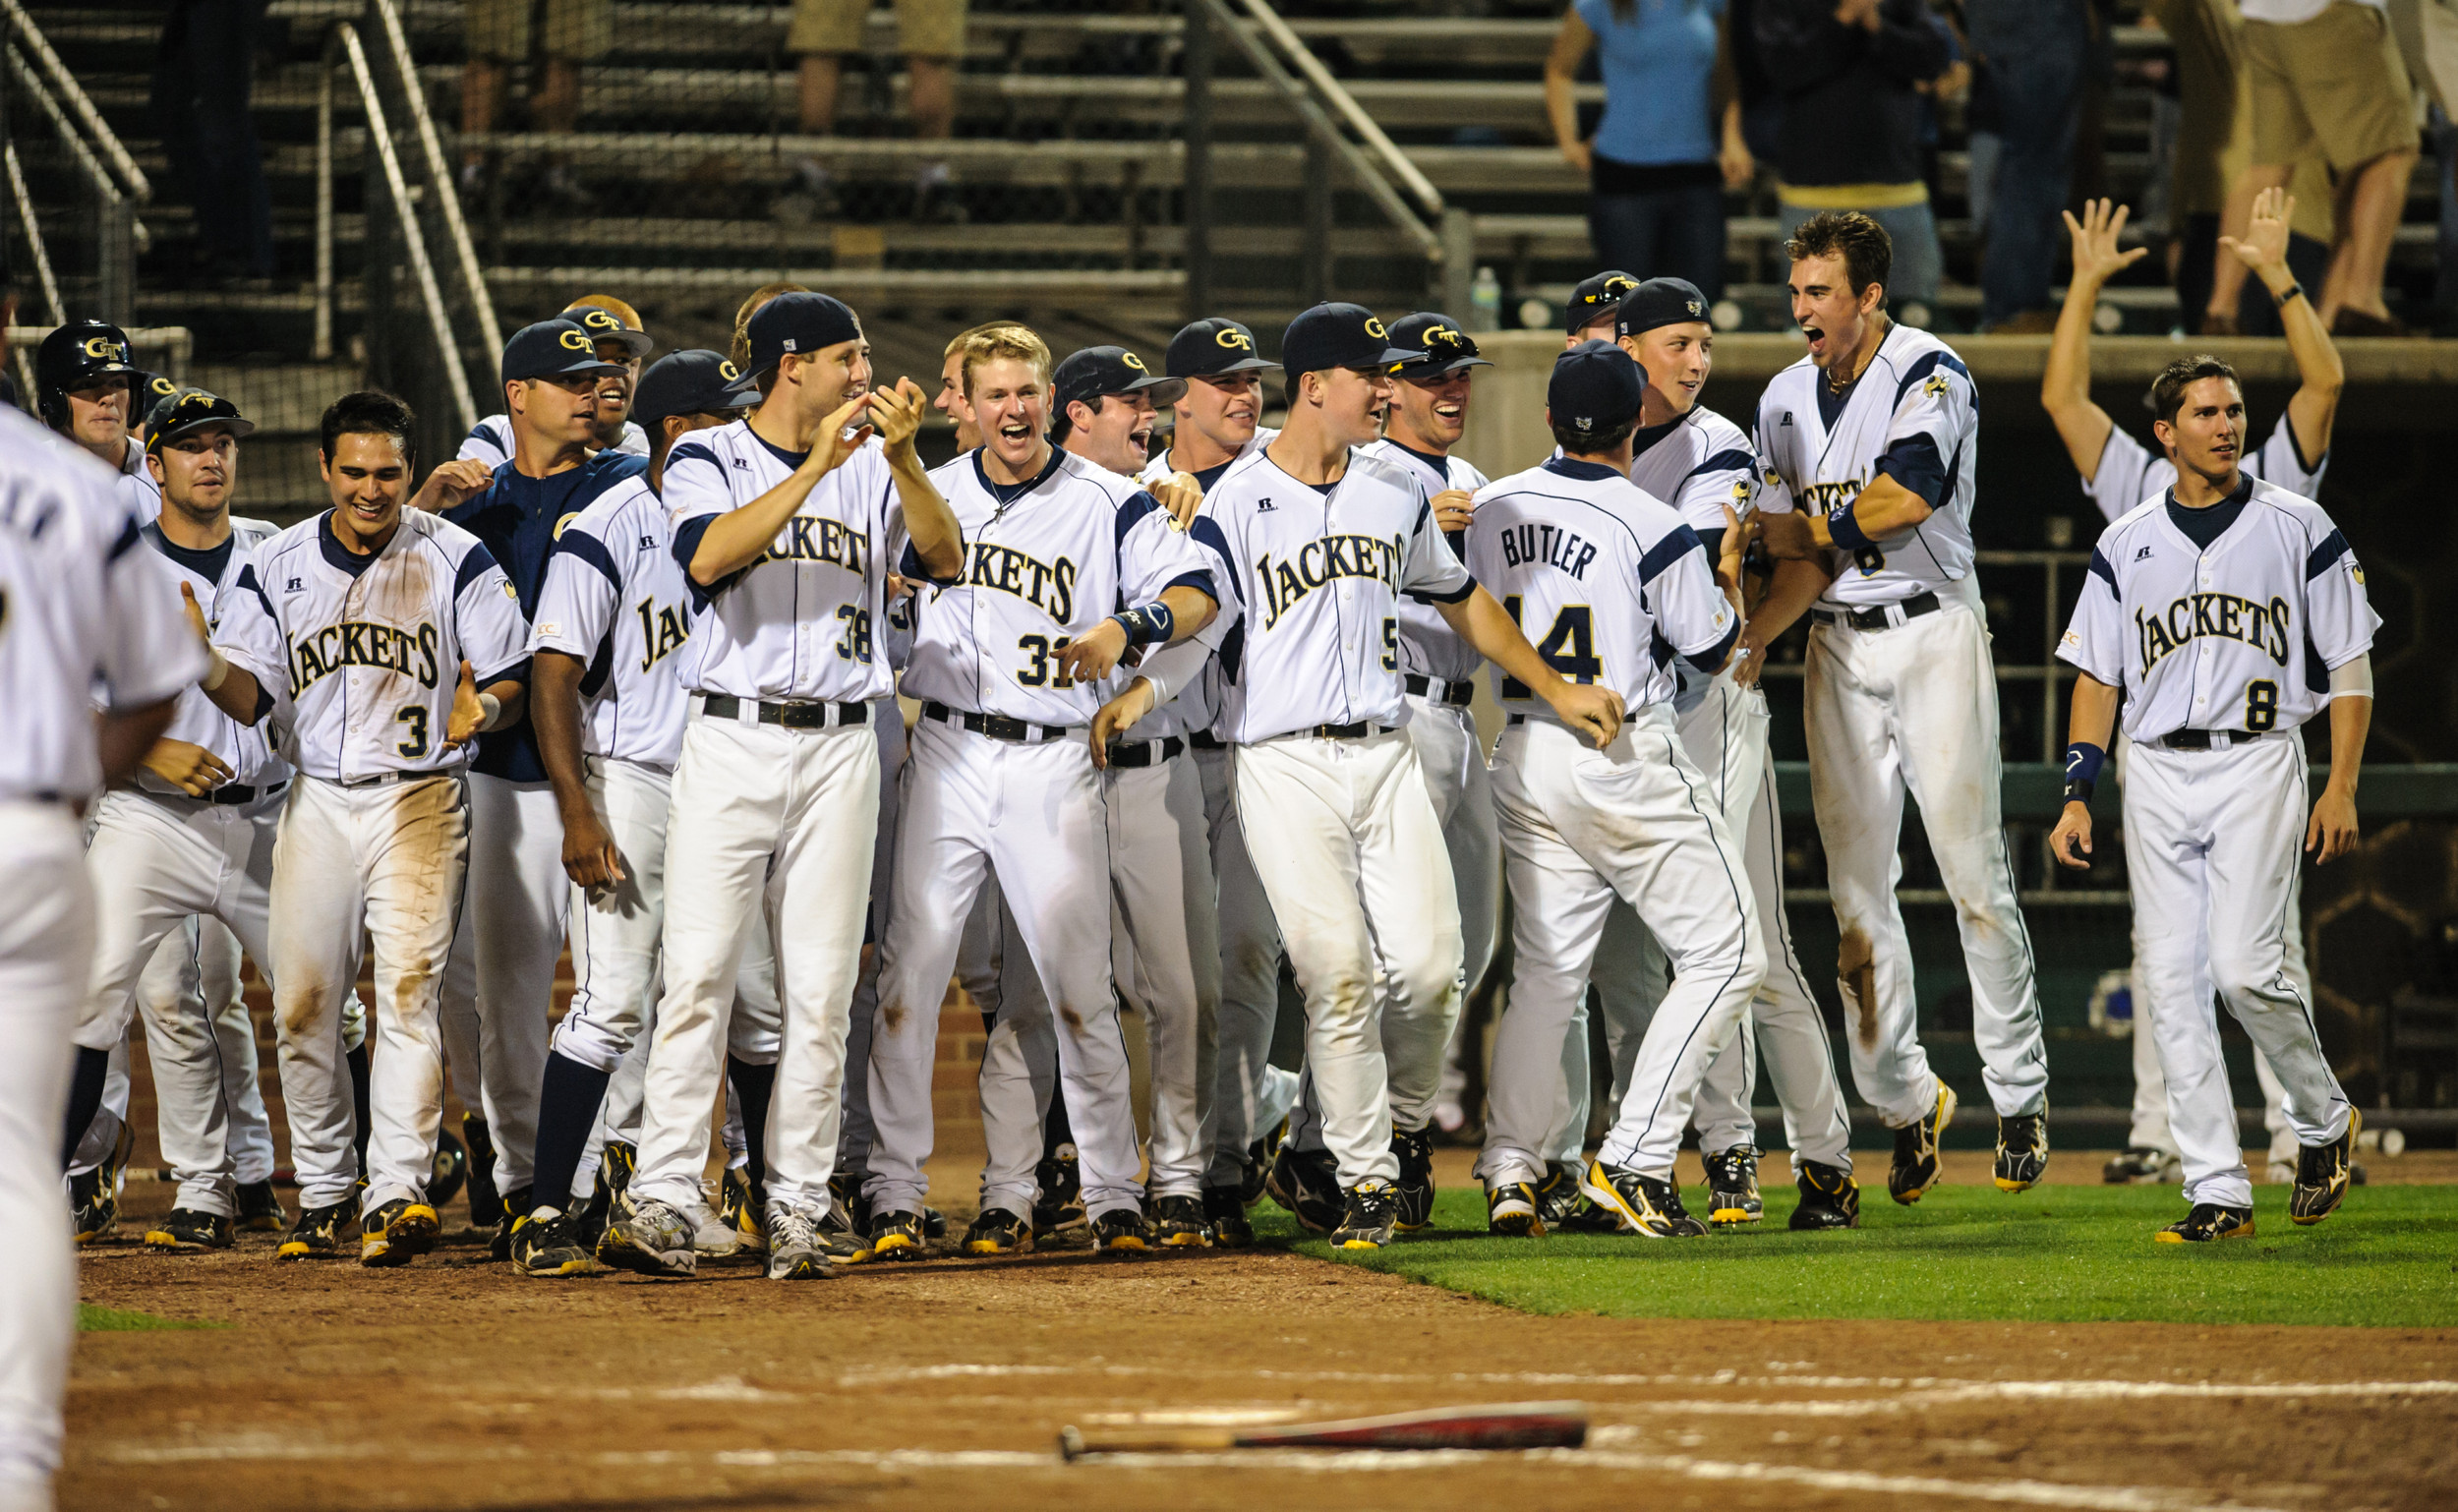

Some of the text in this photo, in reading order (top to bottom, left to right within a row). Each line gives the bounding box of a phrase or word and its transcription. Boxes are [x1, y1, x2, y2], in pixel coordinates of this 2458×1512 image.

[86, 336, 122, 361] GT
[559, 329, 595, 354] GT
[584, 310, 619, 331] GT
[1215, 327, 1251, 351] GT
[1500, 524, 1598, 582] BUTLER
[286, 620, 439, 703] JACKETS
[835, 603, 872, 666] 38
[2135, 592, 2290, 684] JACKETS
[396, 704, 430, 761] 3
[2244, 677, 2280, 733] 8
